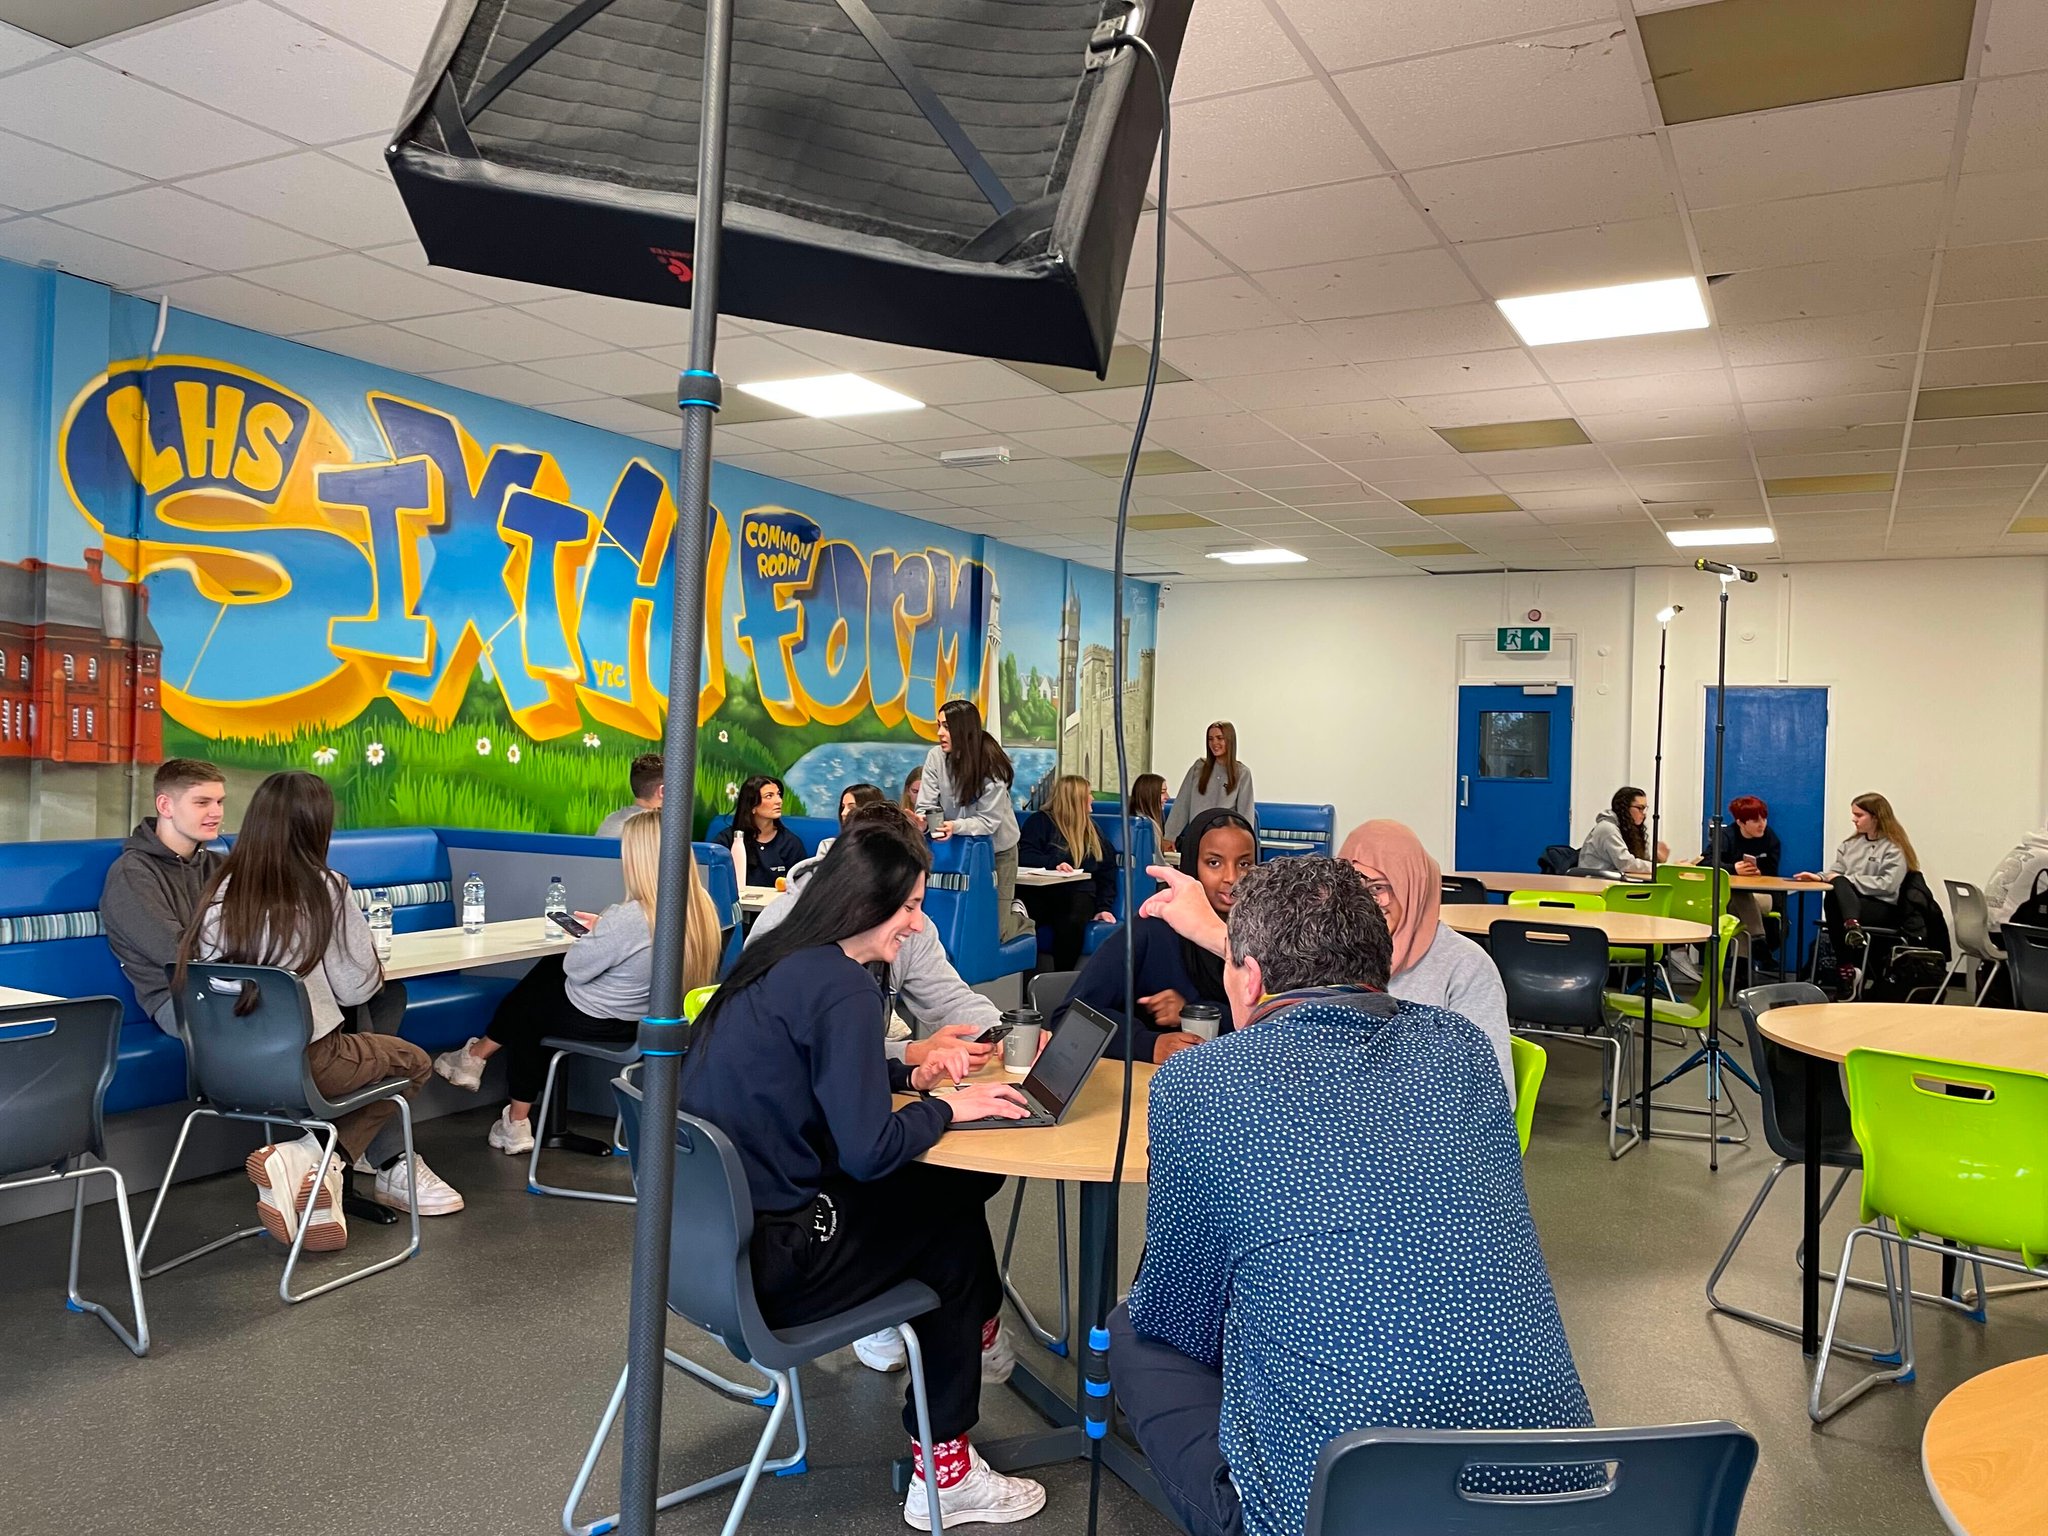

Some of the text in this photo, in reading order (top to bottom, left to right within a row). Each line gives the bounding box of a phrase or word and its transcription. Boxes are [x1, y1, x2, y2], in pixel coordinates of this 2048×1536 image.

[106, 380, 294, 496] LHS
[745, 521, 812, 561] COMMON
[757, 552, 801, 579] ROOM
